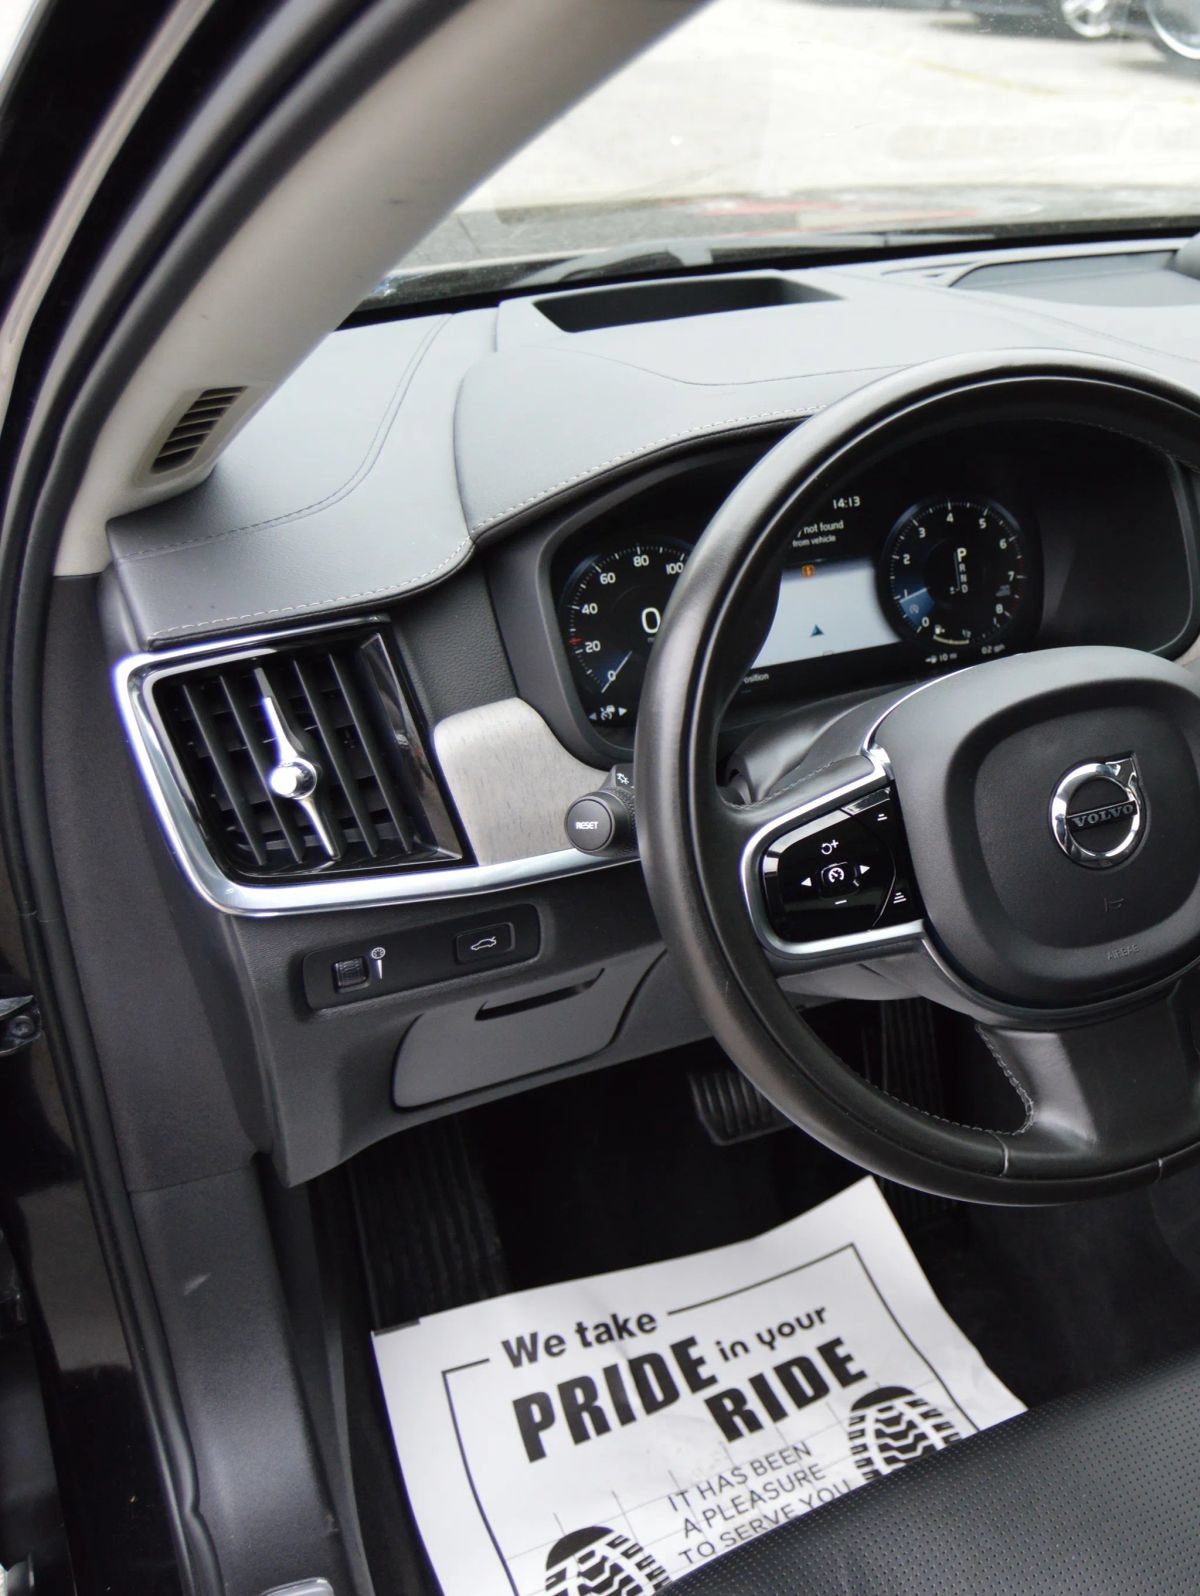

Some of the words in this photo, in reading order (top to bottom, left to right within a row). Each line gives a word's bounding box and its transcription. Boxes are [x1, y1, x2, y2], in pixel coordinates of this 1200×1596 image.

[833, 496, 861, 509] 14:13
[947, 513, 954, 523] 4
[979, 518, 987, 528] 5
[804, 523, 818, 534] not
[820, 520, 844, 532] found
[918, 527, 926, 538] 3
[811, 535, 836, 544] vehicle
[633, 555, 650, 567] 80
[903, 554, 911, 565] 2
[957, 548, 967, 562] P
[665, 562, 684, 575] 100
[600, 572, 616, 584] 60
[581, 603, 598, 615] 40
[641, 607, 661, 634] 0
[585, 640, 601, 653] 20
[744, 672, 770, 683] osition
[1071, 804, 1134, 827] VOLVO
[575, 821, 599, 830] RESET
[501, 1331, 567, 1369] We
[574, 1313, 657, 1349] take
[512, 1336, 719, 1463] PRIDE
[715, 1340, 751, 1362] in
[755, 1306, 827, 1351] your
[704, 1336, 869, 1443] RIDE
[667, 1490, 691, 1512] IT
[696, 1466, 748, 1500] HAS
[750, 1441, 812, 1477] BEEN
[683, 1517, 702, 1539] A
[702, 1463, 826, 1529] PLEASURE
[678, 1541, 716, 1565] TO
[719, 1503, 796, 1548] SERVE
[798, 1479, 851, 1510] YOU
